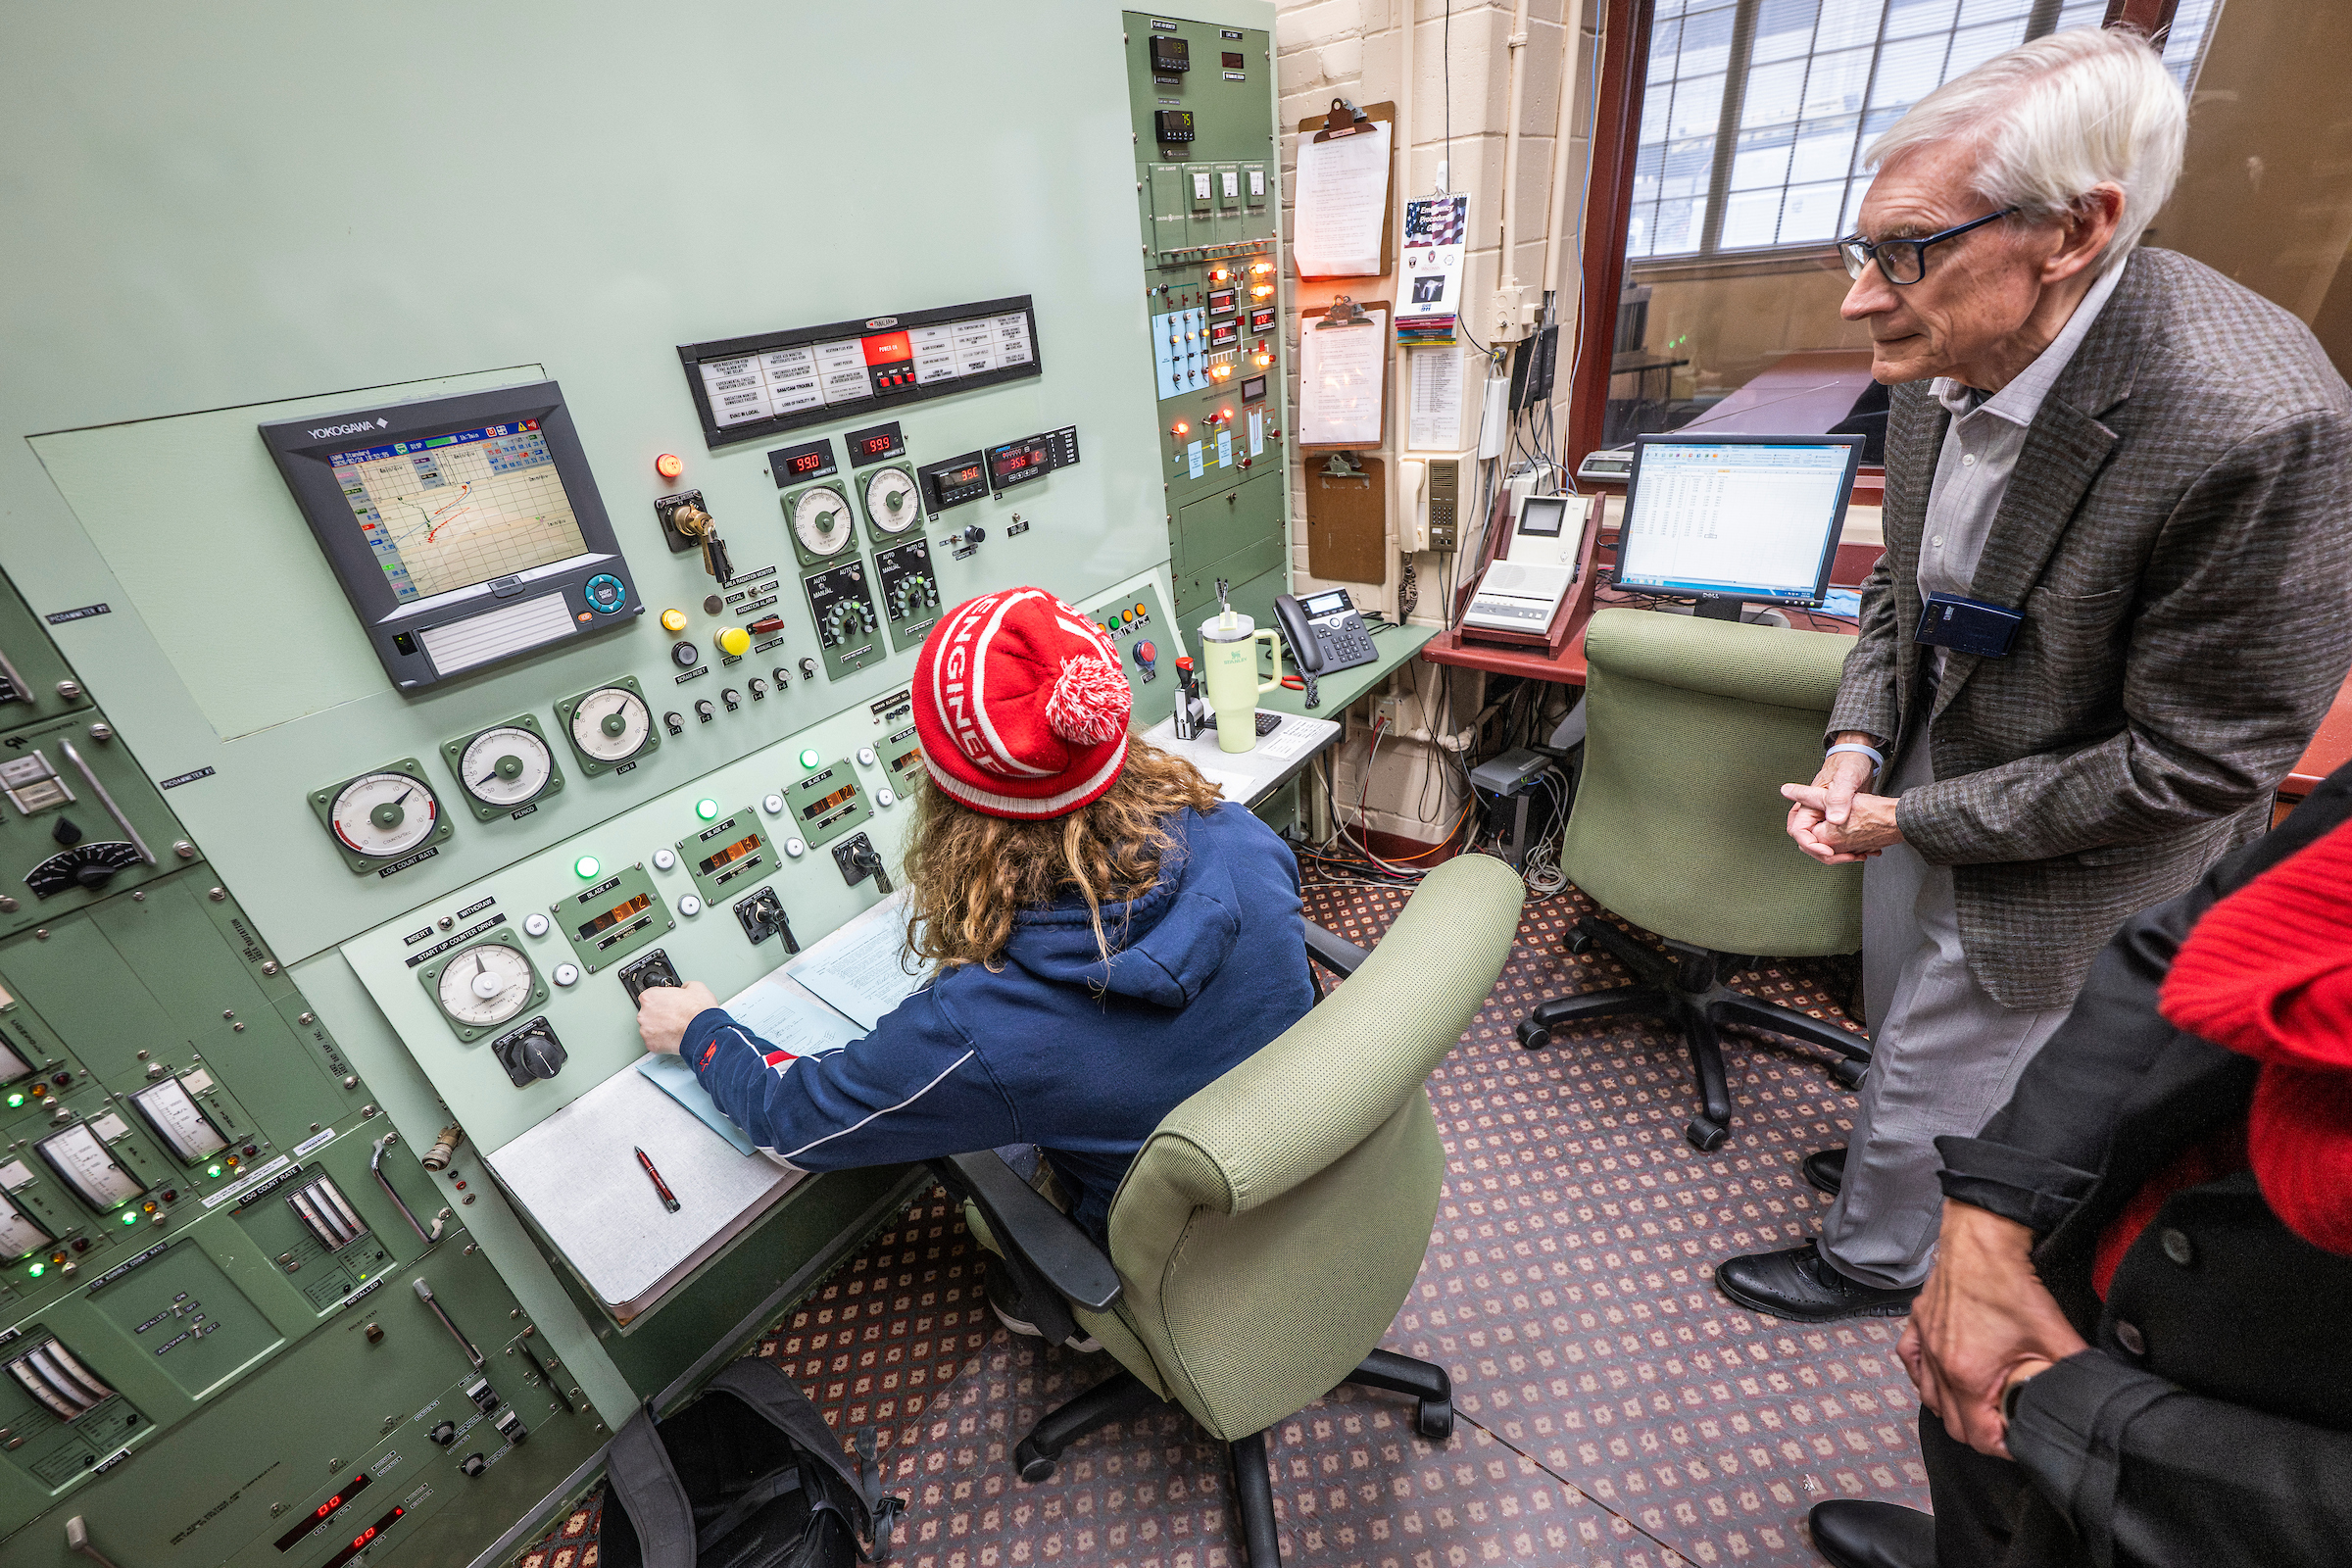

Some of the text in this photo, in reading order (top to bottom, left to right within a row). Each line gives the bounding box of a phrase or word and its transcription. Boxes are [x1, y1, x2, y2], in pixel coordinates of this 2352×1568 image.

[1420, 204, 1454, 214] Emergency
[1426, 223, 1445, 232] Guide
[307, 419, 374, 440] YOKOGAWA
[906, 544, 917, 553] AUTO
[883, 551, 895, 560] AUTO
[840, 566, 852, 576] AUTO
[882, 564, 900, 573] MANUAL
[724, 567, 775, 589] AREA RADIATION MONITOR
[813, 575, 826, 585] AUTO
[727, 594, 743, 603] LOCAL
[813, 588, 833, 599] MANUAL
[737, 597, 775, 615] RADIATION ALARM
[756, 638, 782, 653] MANUAL EVAC
[1223, 657, 1248, 665] STANLEY
[677, 667, 707, 683] SCRAM RESET
[873, 703, 886, 711] SERVO
[886, 697, 901, 706] ELEMENT
[619, 765, 630, 774] LOG
[163, 772, 203, 788] PICOAMMETER
[807, 776, 820, 786] BLADE
[515, 806, 535, 819] PERIOD
[706, 827, 722, 838] BLADE
[382, 849, 435, 876] LOG COUNT RATE
[587, 887, 605, 898] BLADE
[459, 898, 492, 917] WITHDRAW
[230, 919, 264, 960] AREA RADIATION
[407, 928, 430, 944] INSERT
[417, 920, 495, 961] START UP COUNTER DRIVE
[242, 1167, 298, 1203] LOG COUNT RATE
[105, 1265, 129, 1280] AUDIBLE
[130, 1253, 148, 1267] COUNT
[150, 1244, 165, 1255] RATE
[346, 1281, 379, 1306] INSTALLED
[186, 1303, 197, 1311] OFF
[138, 1312, 168, 1331] INSTALLED
[366, 1310, 377, 1320] TEST
[206, 1324, 217, 1333] OFF
[98, 1453, 125, 1473] SPARE
